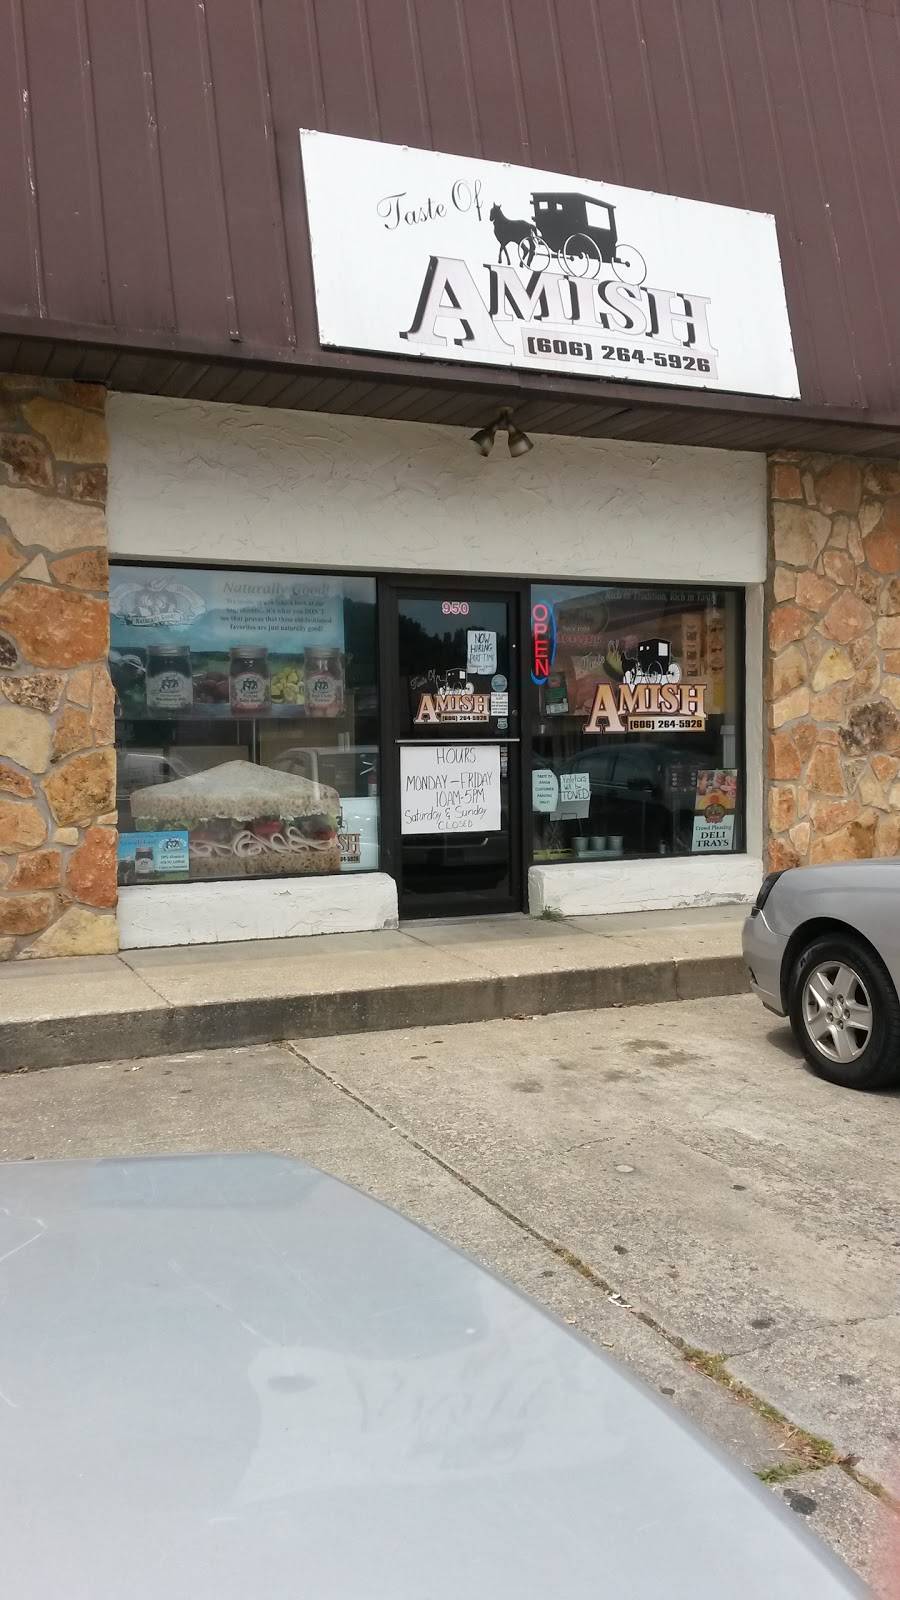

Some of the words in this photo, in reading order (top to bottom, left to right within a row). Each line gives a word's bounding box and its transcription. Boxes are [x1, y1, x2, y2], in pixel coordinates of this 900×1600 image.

[376, 192, 448, 231] Taste
[451, 179, 483, 222] Of
[400, 254, 719, 357] AMISH
[601, 344, 711, 374] 264-5926
[223, 581, 288, 597] Naturally
[291, 583, 330, 597] Good!
[442, 601, 469, 614] 950
[474, 632, 491, 643] NOW
[532, 604, 550, 677] OPEN
[470, 642, 493, 653] HIRING
[413, 693, 491, 724] AMISH
[582, 682, 709, 735] AMISH
[657, 719, 703, 729] 264-5926
[436, 747, 477, 764] HOURS
[405, 774, 448, 792] MONDAY
[460, 772, 493, 789] FRIDAY
[561, 788, 591, 800] TOWED
[444, 807, 451, 820] &
[454, 805, 487, 819] Sunday
[437, 820, 473, 830] CLOSED
[700, 831, 726, 839] DELI
[696, 839, 730, 848] TRAYS
